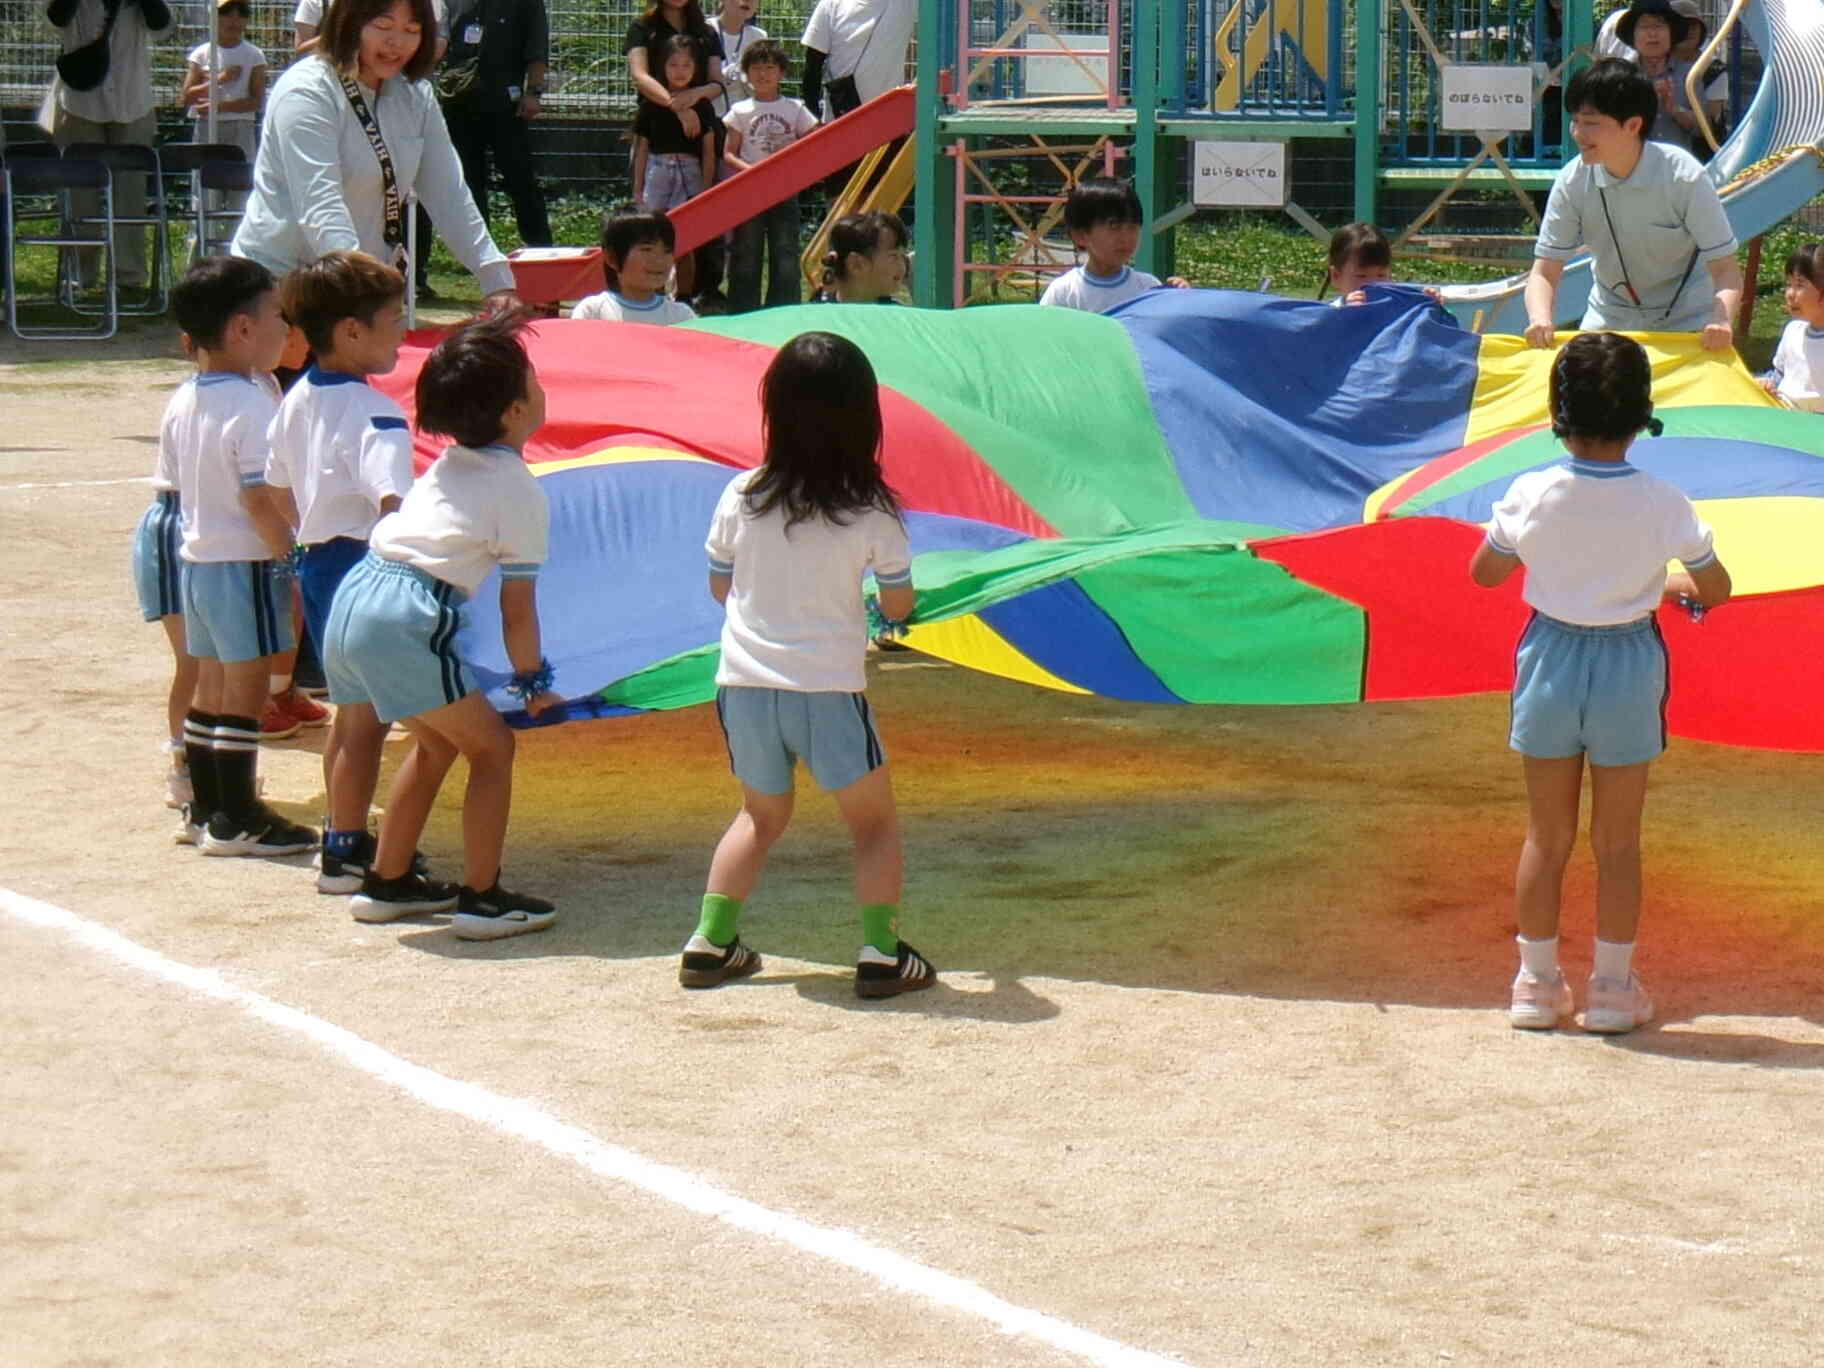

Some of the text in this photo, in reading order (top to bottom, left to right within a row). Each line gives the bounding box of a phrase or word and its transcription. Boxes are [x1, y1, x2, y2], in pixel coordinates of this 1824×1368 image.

[1201, 164, 1277, 178] はいらないでね
